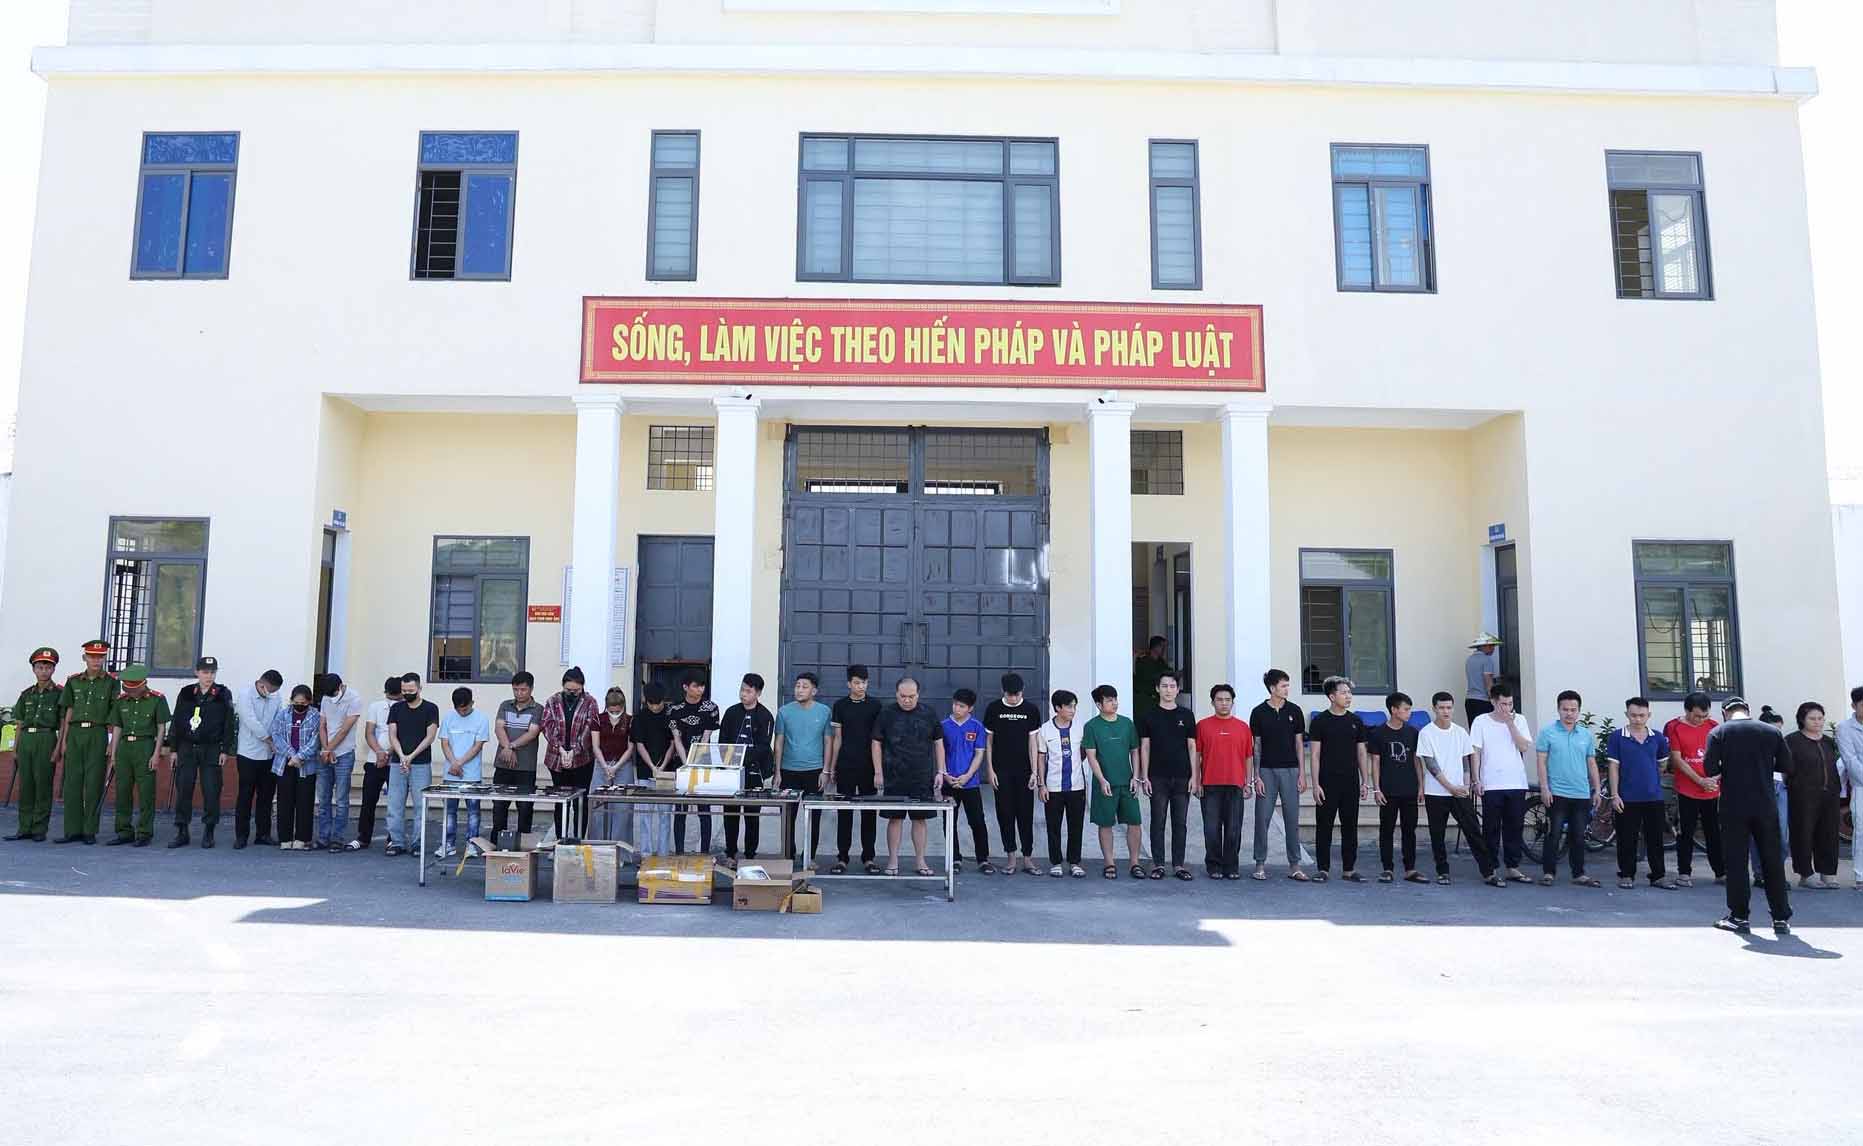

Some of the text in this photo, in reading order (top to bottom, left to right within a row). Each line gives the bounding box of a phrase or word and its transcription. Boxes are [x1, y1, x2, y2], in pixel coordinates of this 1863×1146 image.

[611, 311, 1234, 377] SỐNG, LÀM VIỆC THEO HIẾN PHÁP VÀ PHÁP LUẬT
